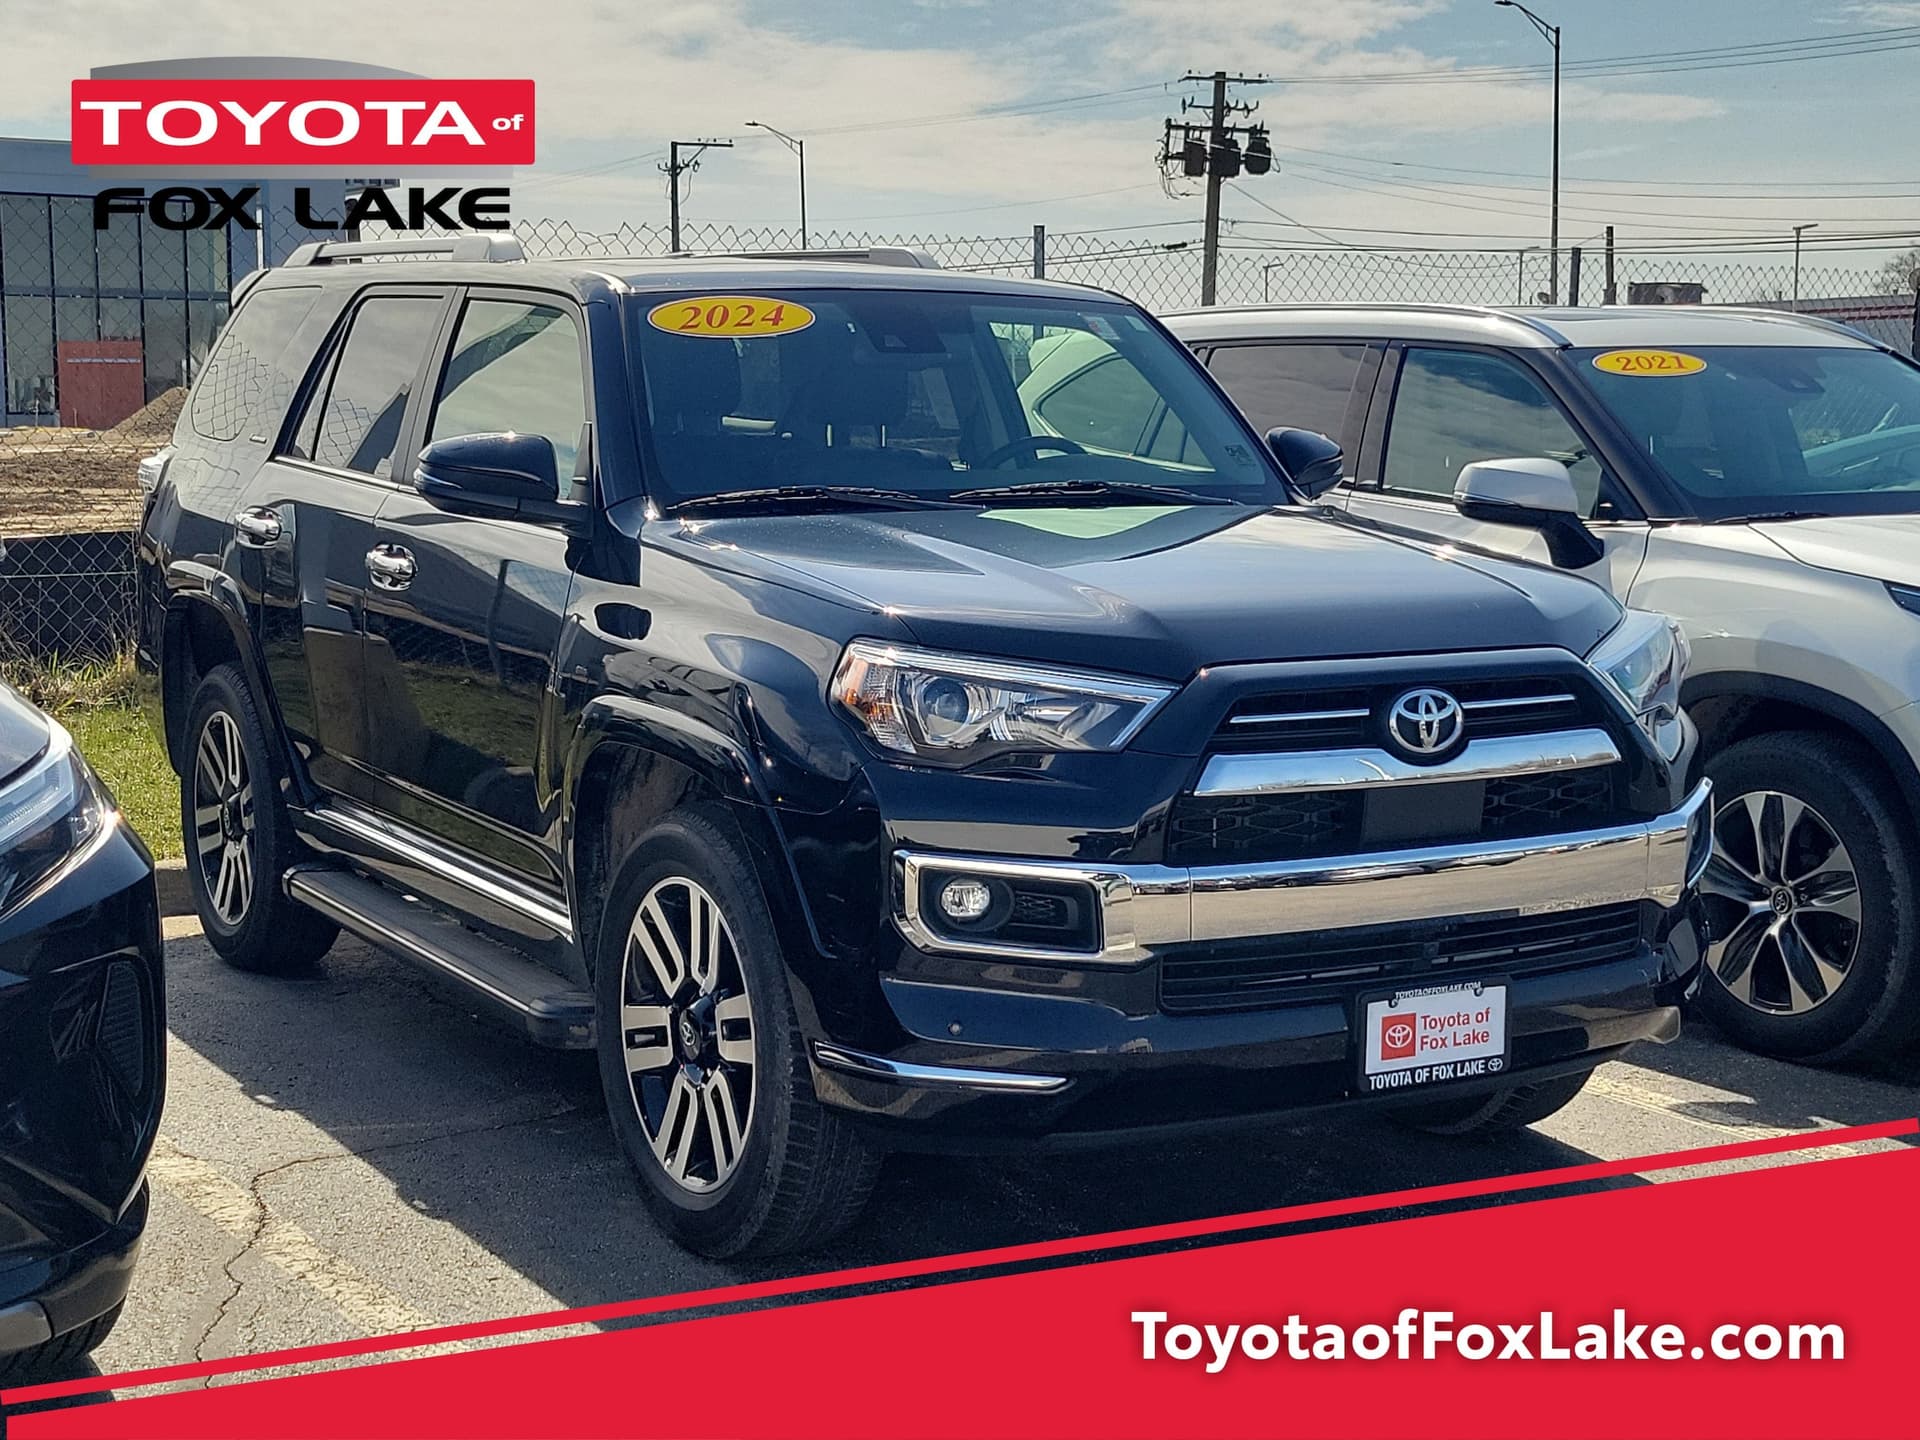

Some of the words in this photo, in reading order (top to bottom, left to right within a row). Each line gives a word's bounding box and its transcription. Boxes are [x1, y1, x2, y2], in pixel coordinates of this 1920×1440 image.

[679, 304, 785, 330] 2024
[1616, 355, 1688, 371] 2021
[1421, 1011, 1470, 1033] Toyota
[1476, 1007, 1491, 1023] of
[1420, 1035, 1448, 1051] Fox
[1453, 1029, 1490, 1047] Lake
[1369, 1071, 1412, 1091] TOYOTA
[1415, 1068, 1430, 1083] OF
[1432, 1064, 1454, 1081] FOX
[1456, 1060, 1485, 1077] LAKE
